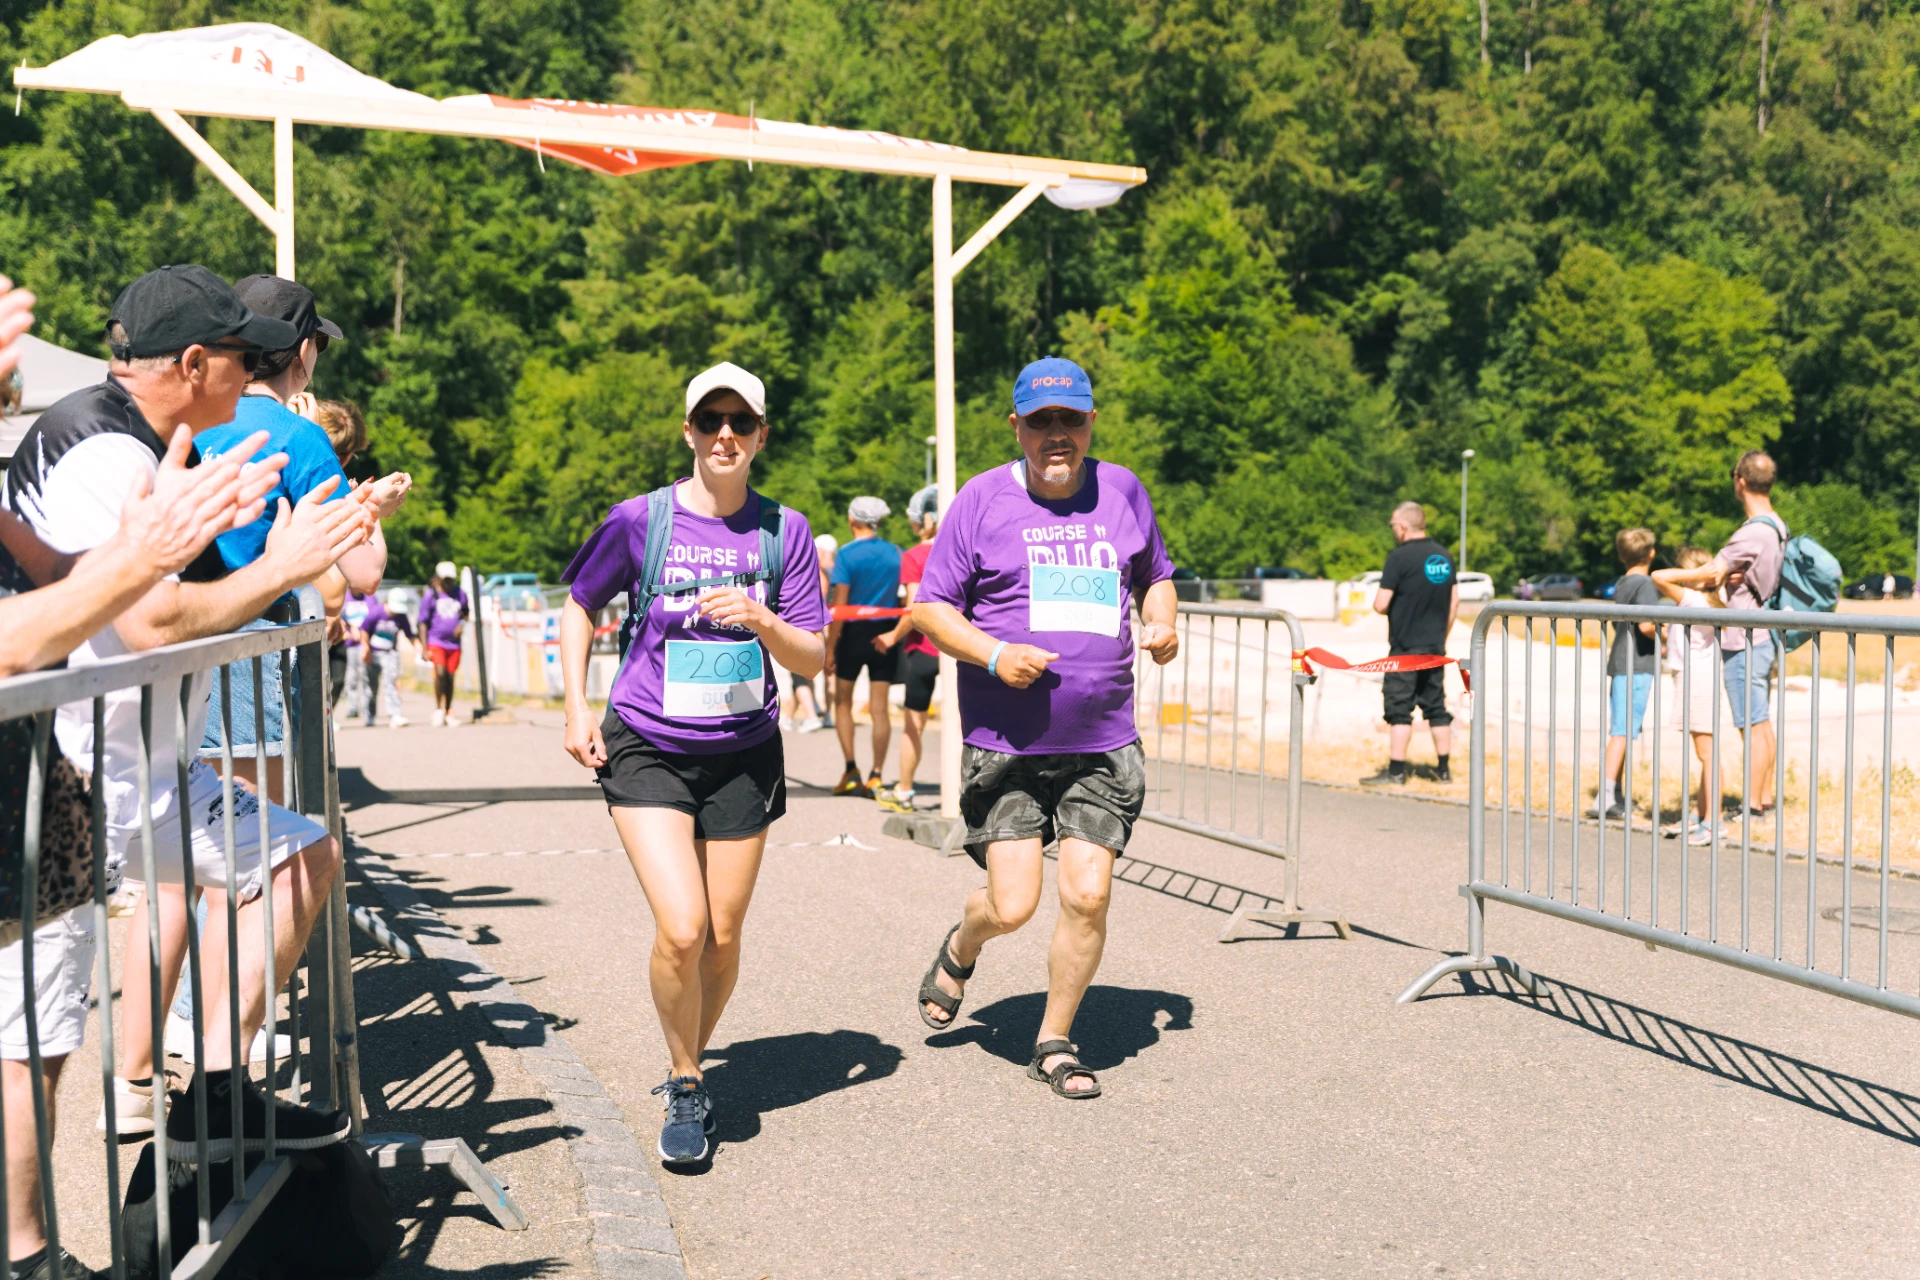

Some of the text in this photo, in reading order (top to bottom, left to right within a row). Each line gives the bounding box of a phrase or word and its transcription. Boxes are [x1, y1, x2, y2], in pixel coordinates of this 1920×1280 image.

[1032, 376, 1073, 390] procap
[1022, 524, 1087, 542] COURSE
[1049, 571, 1106, 601] 208
[709, 619, 758, 635] SUIS
[685, 648, 753, 679] 208
